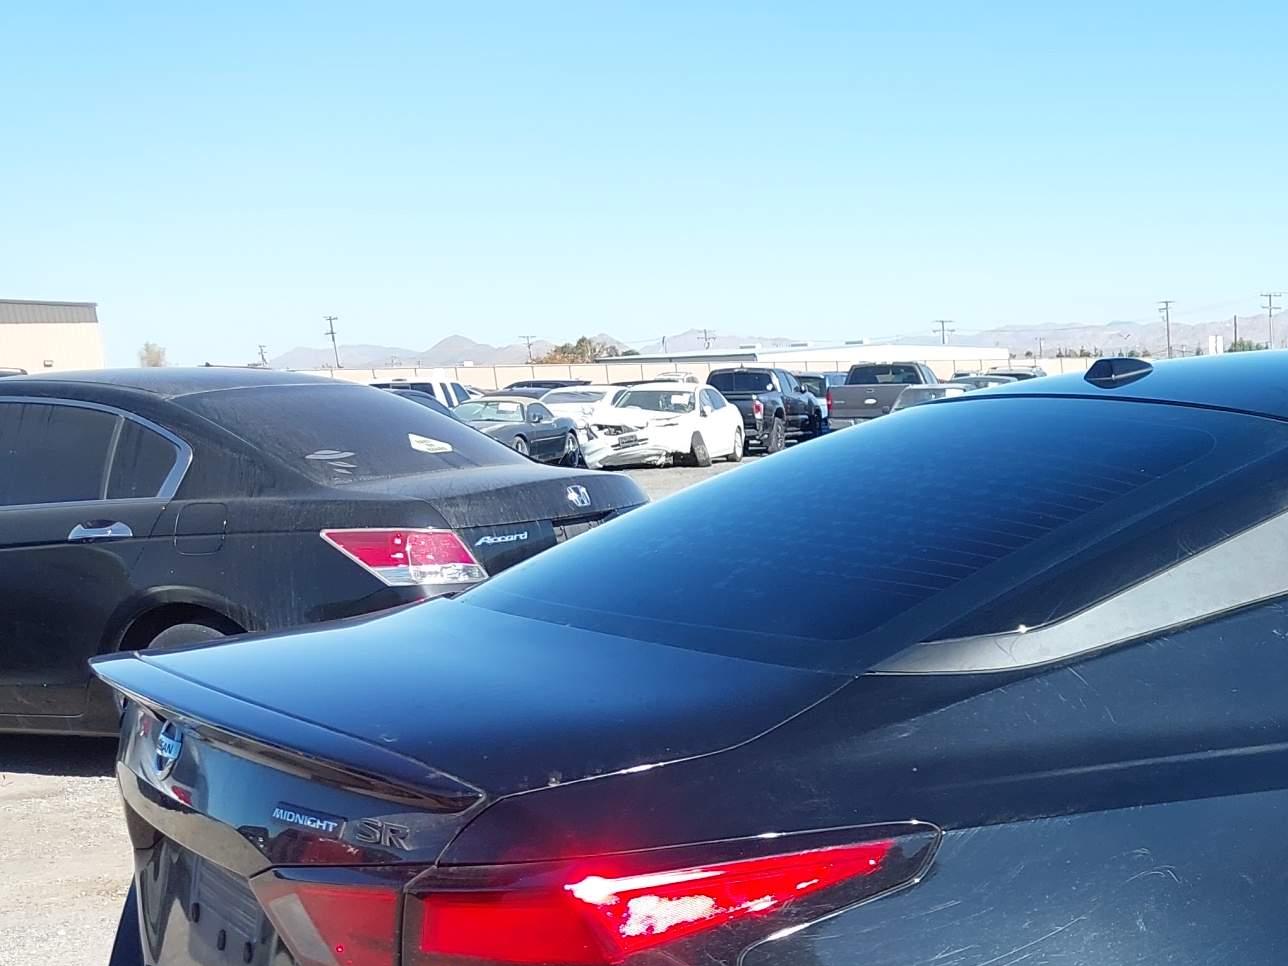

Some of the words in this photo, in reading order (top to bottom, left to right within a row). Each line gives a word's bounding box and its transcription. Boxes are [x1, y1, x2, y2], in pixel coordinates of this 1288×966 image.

[475, 531, 528, 547] Accord
[272, 807, 338, 832] MIDNIGHT
[356, 818, 413, 851] SR
